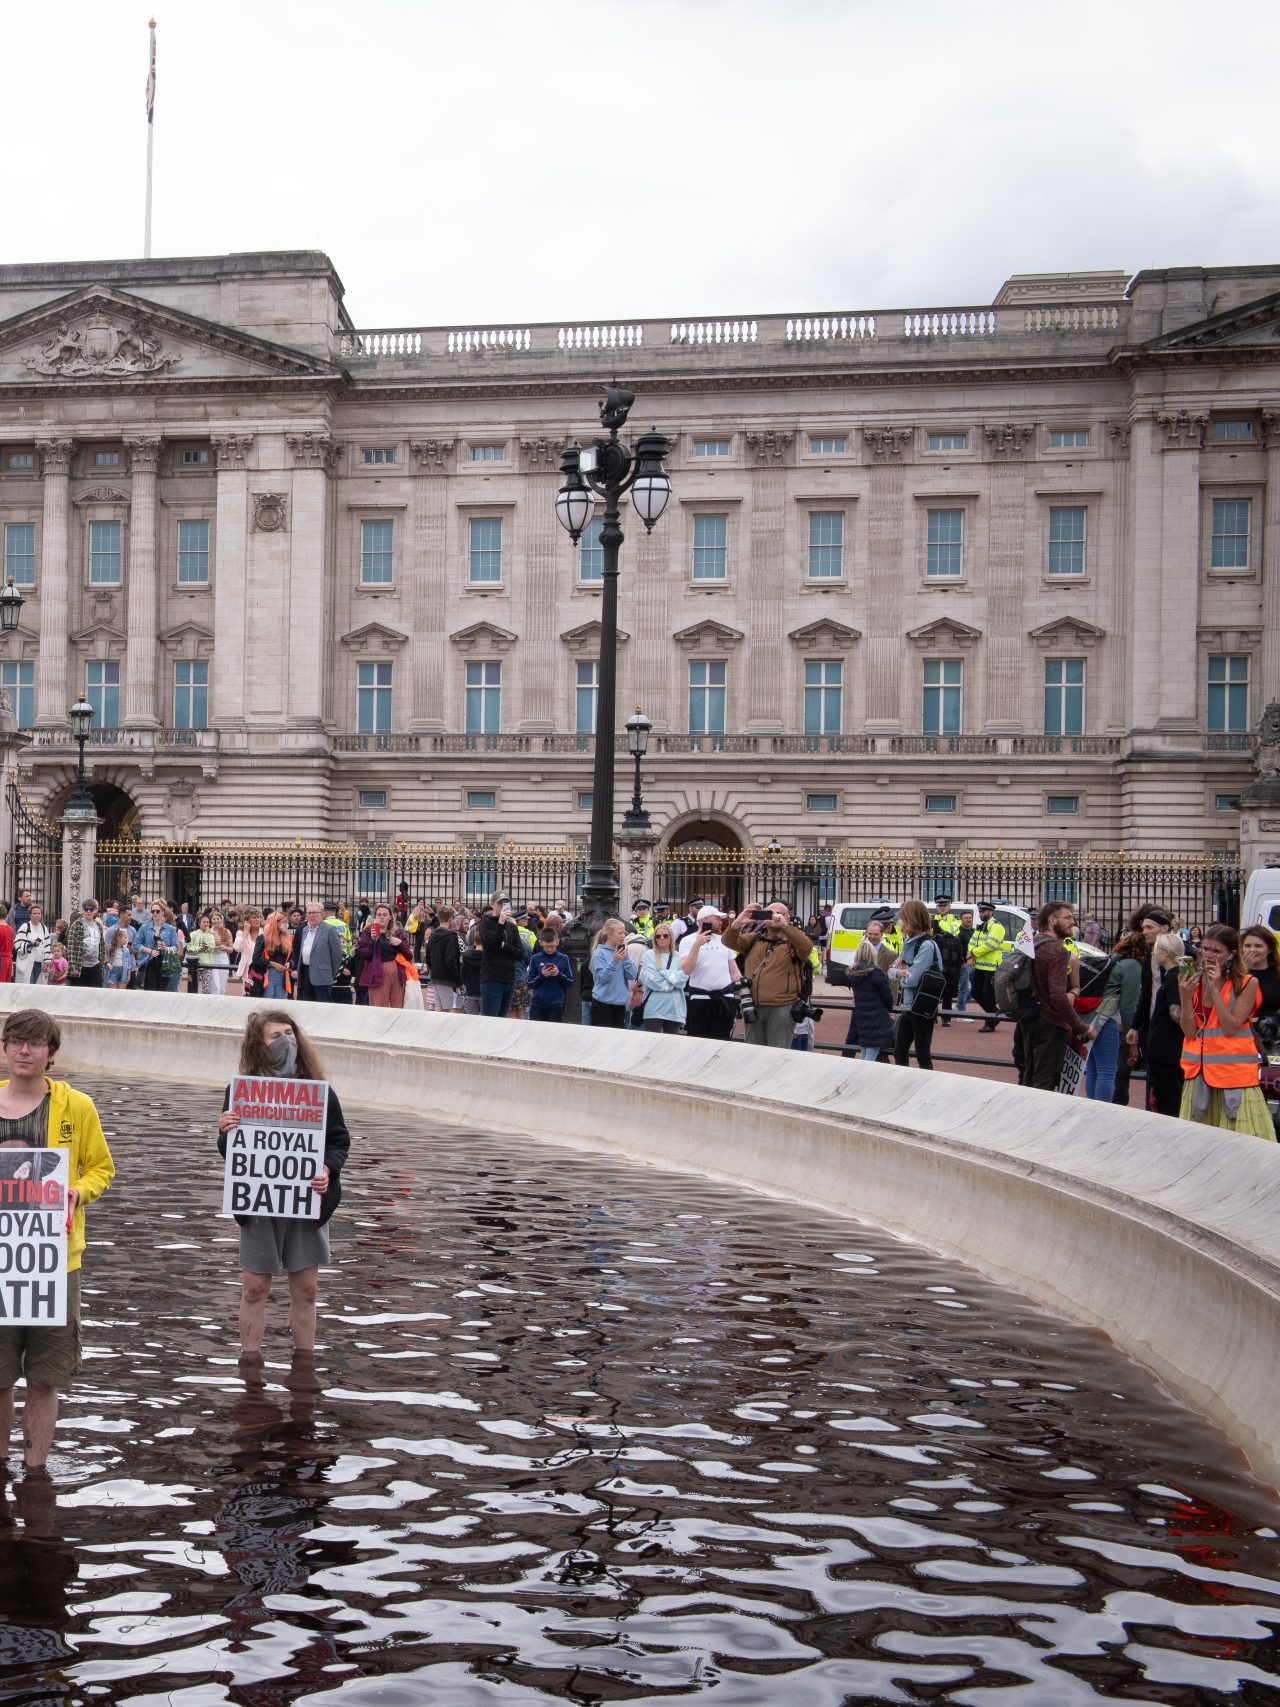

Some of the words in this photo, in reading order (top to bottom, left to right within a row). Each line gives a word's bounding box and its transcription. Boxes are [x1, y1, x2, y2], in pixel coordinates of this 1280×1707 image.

[1066, 1048, 1082, 1072] OYAL
[1062, 1061, 1080, 1085] OOD
[233, 1079, 324, 1107] ANIMAL
[234, 1104, 323, 1123] AGRICULTURE
[232, 1129, 246, 1148] A
[253, 1130, 319, 1153] ROYAL
[232, 1152, 316, 1180] BLOOD
[231, 1182, 313, 1215] BATH
